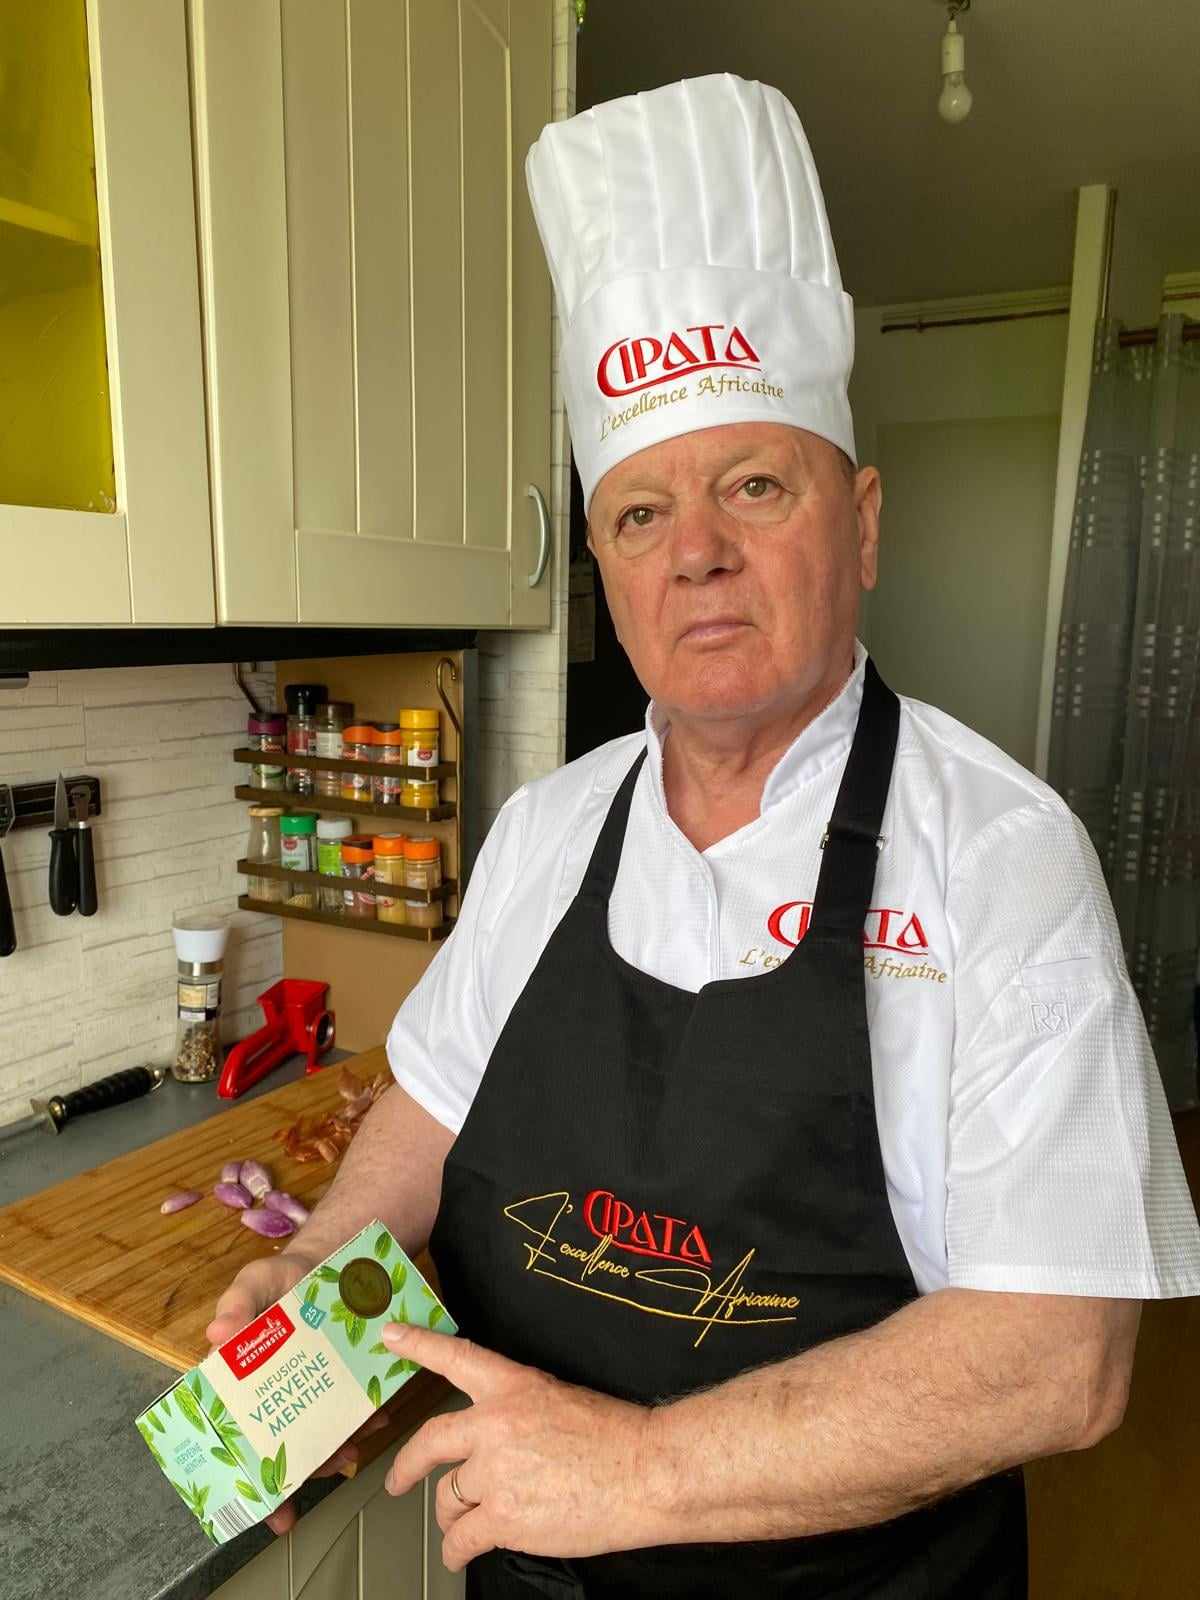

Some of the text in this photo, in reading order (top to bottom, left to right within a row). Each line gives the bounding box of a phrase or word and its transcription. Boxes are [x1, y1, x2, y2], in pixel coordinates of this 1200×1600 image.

[597, 325, 761, 397] CIPATA
[600, 374, 785, 441] L'excellence Africaine
[767, 901, 928, 956] CITA
[583, 1189, 712, 1270] CIPATA
[305, 1307, 317, 1321] 25
[239, 1327, 287, 1368] WESTMINSTER
[255, 1350, 307, 1398] INFUSION
[249, 1352, 329, 1423] VERVEINE
[268, 1372, 335, 1437] MENTHE
